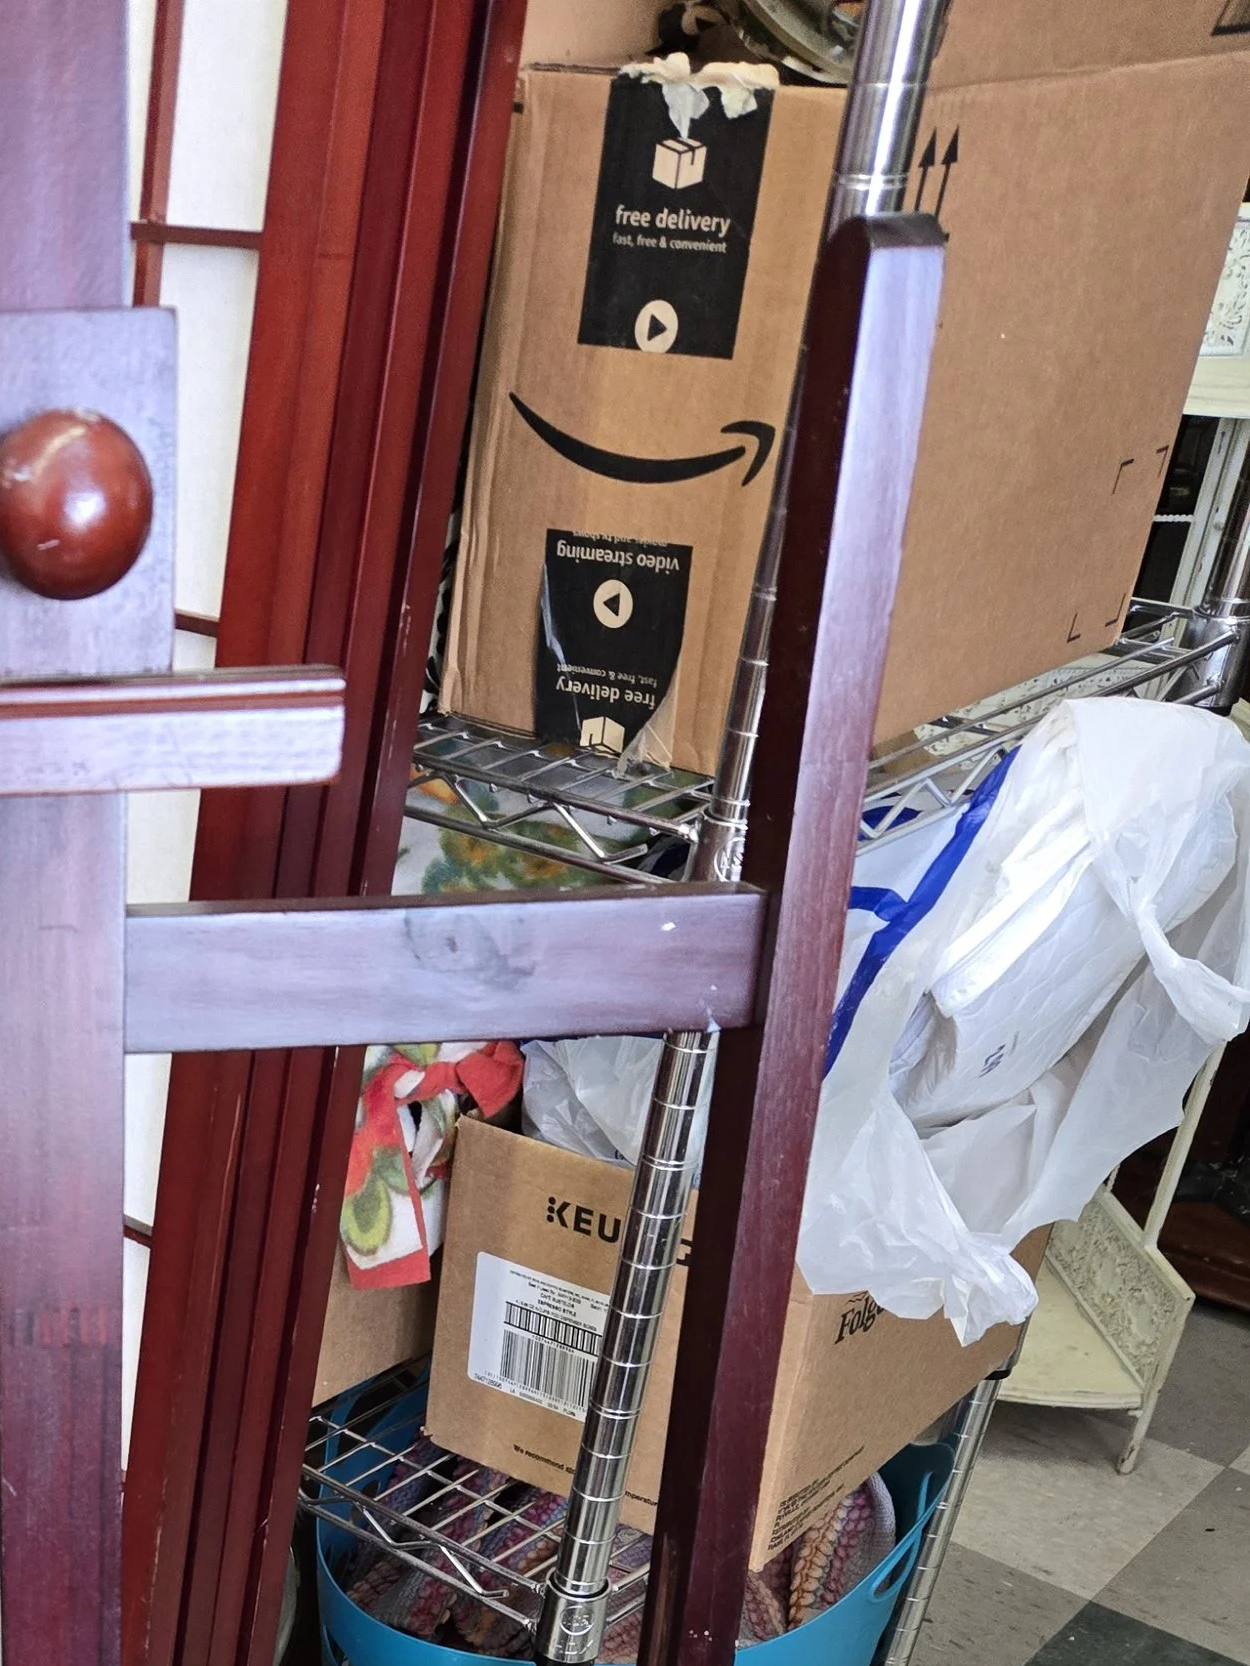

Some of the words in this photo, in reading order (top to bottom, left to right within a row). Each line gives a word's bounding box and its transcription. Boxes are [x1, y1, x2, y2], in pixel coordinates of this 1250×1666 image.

[615, 204, 651, 227] free
[655, 207, 731, 238] delivery
[612, 232, 634, 247] fast,
[637, 234, 657, 248] free
[659, 236, 668, 249] &
[669, 238, 727, 253] convenient
[556, 539, 633, 567] streaming
[636, 553, 680, 575] video
[555, 676, 620, 703] delivery
[617, 672, 636, 685] free
[624, 689, 656, 710] free
